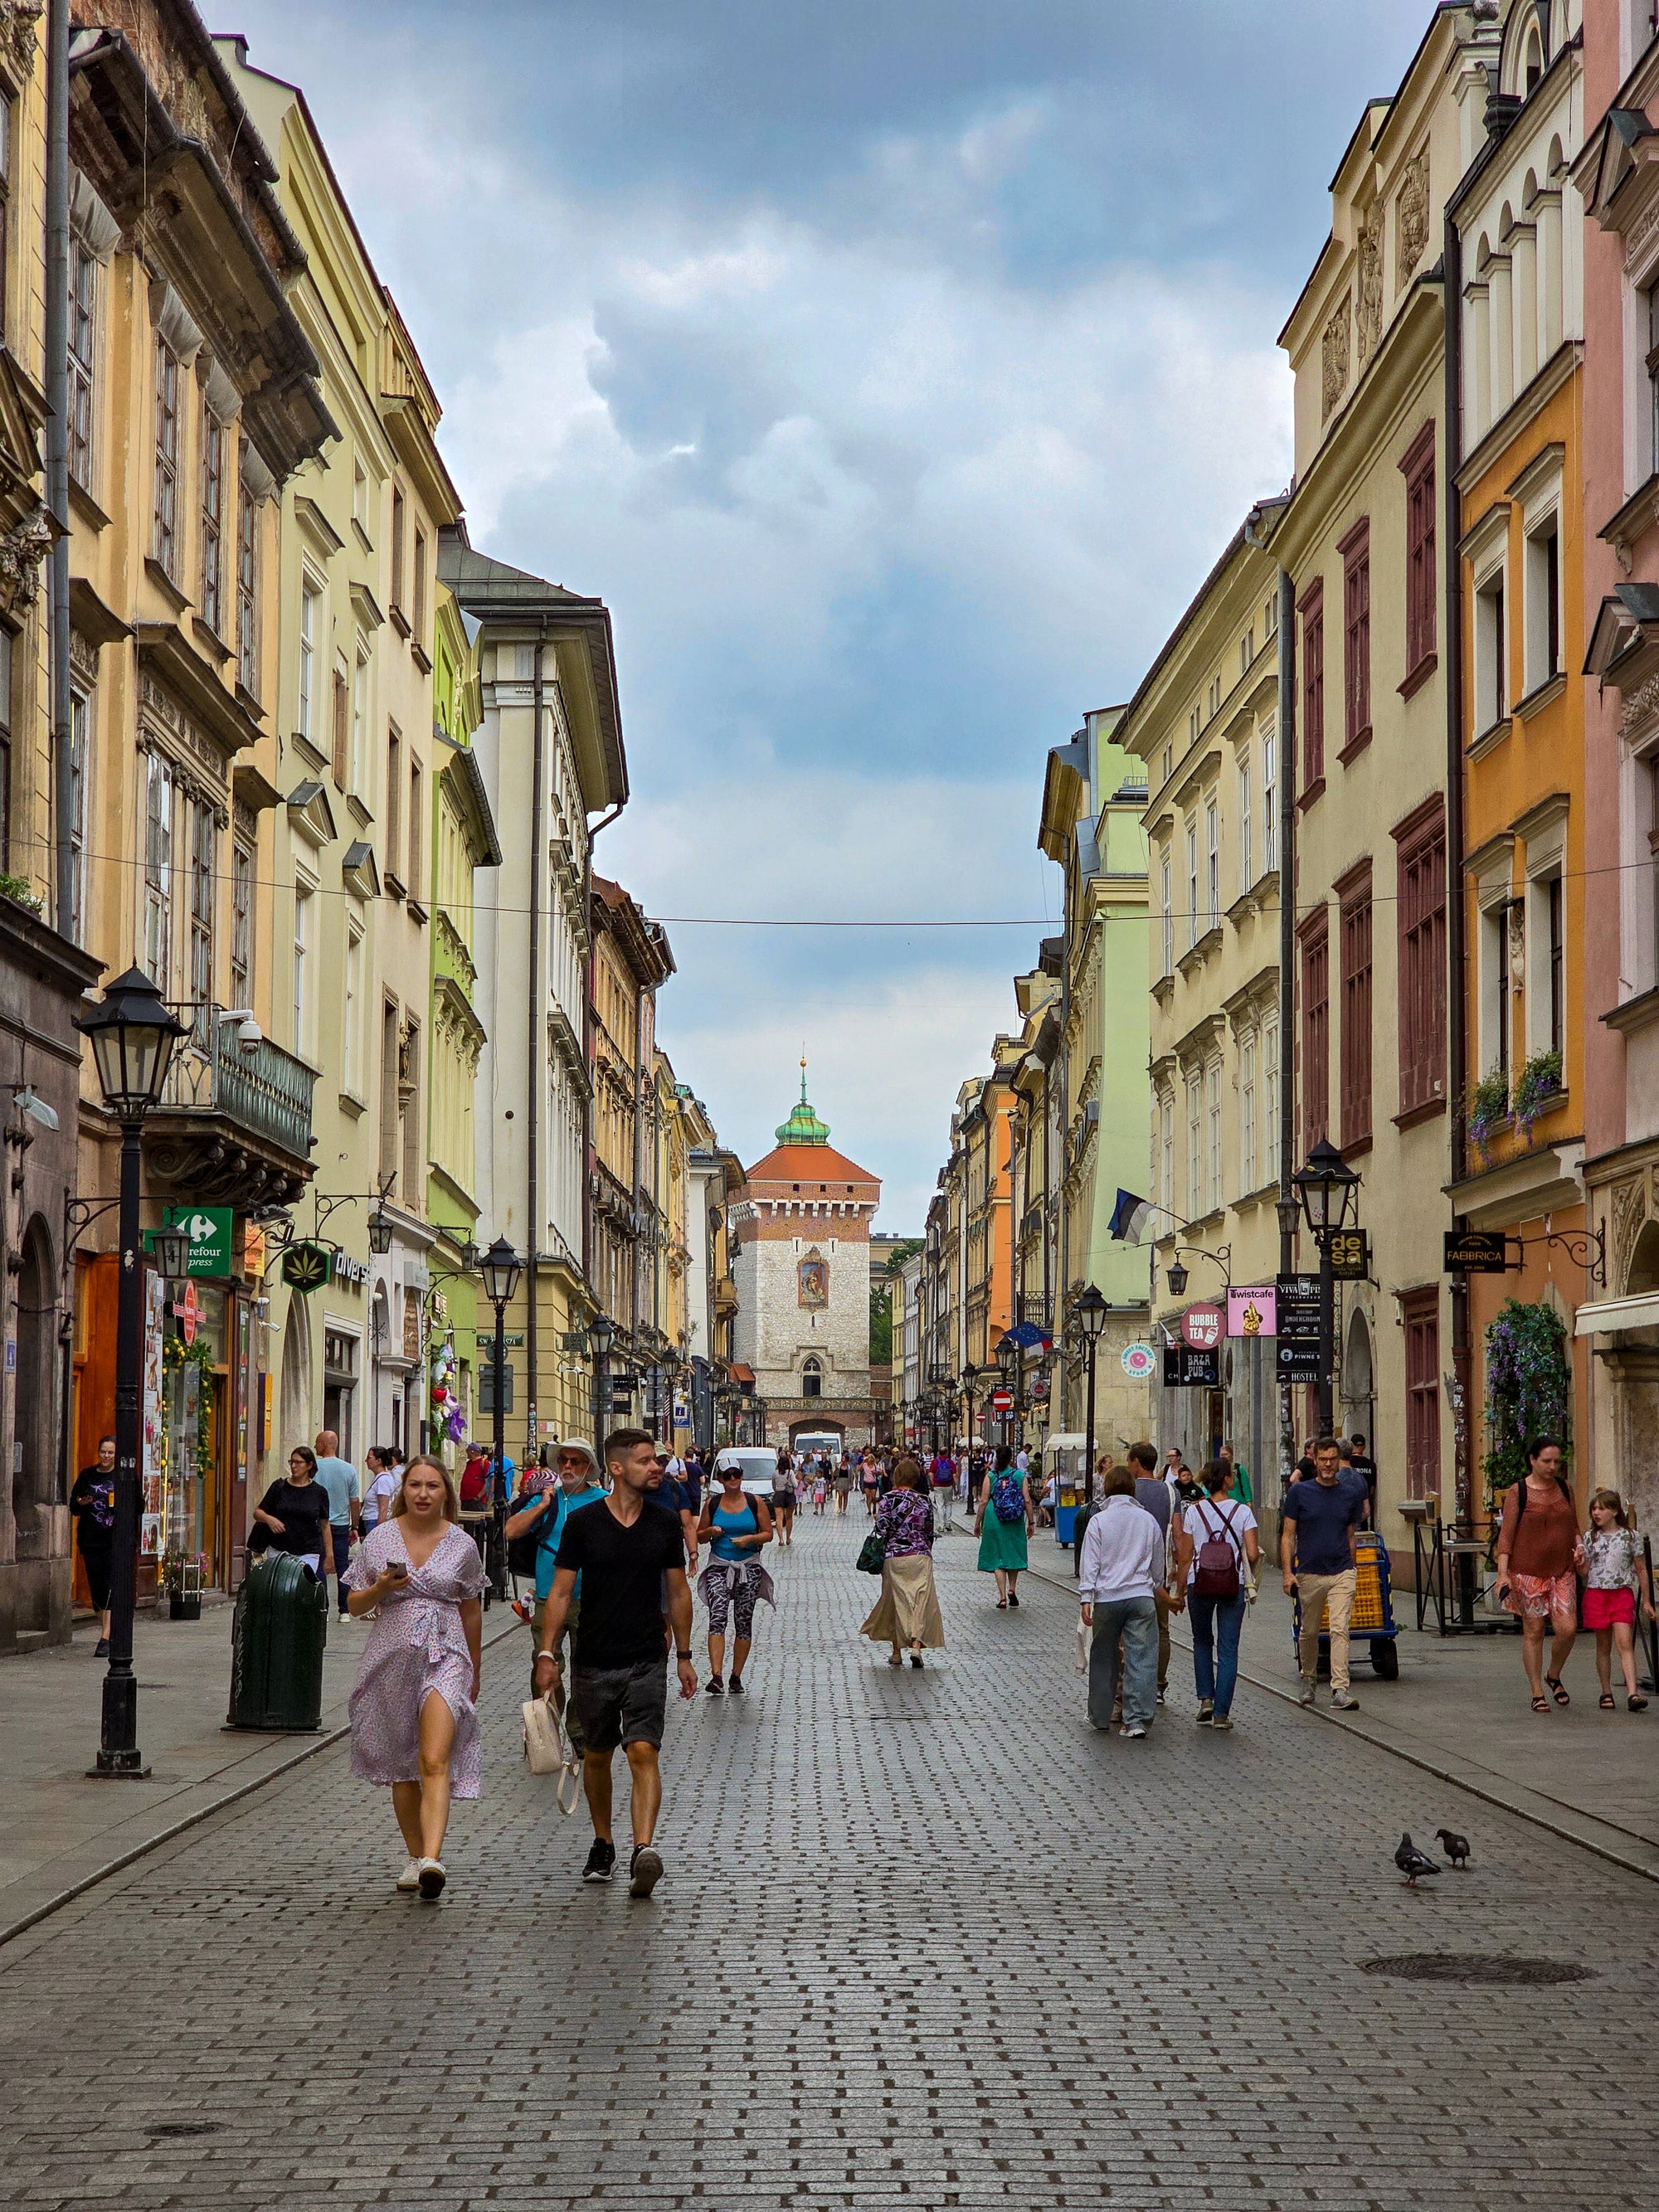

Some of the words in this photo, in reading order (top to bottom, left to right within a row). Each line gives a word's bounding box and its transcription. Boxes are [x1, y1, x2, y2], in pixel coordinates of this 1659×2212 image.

[1331, 1235, 1361, 1251] de
[188, 1246, 221, 1257] refour
[1447, 1251, 1502, 1262] FABBRICA
[1331, 1251, 1361, 1265] sa
[187, 1259, 213, 1270] press
[1229, 1289, 1273, 1299] Twistcafe
[1278, 1284, 1298, 1294] VIVA
[1189, 1315, 1219, 1326] BUBBLE
[1189, 1328, 1204, 1339] TEA
[1188, 1354, 1210, 1366] BAZA
[1188, 1366, 1204, 1378] PUB
[1291, 1373, 1319, 1382] HOSTEL
